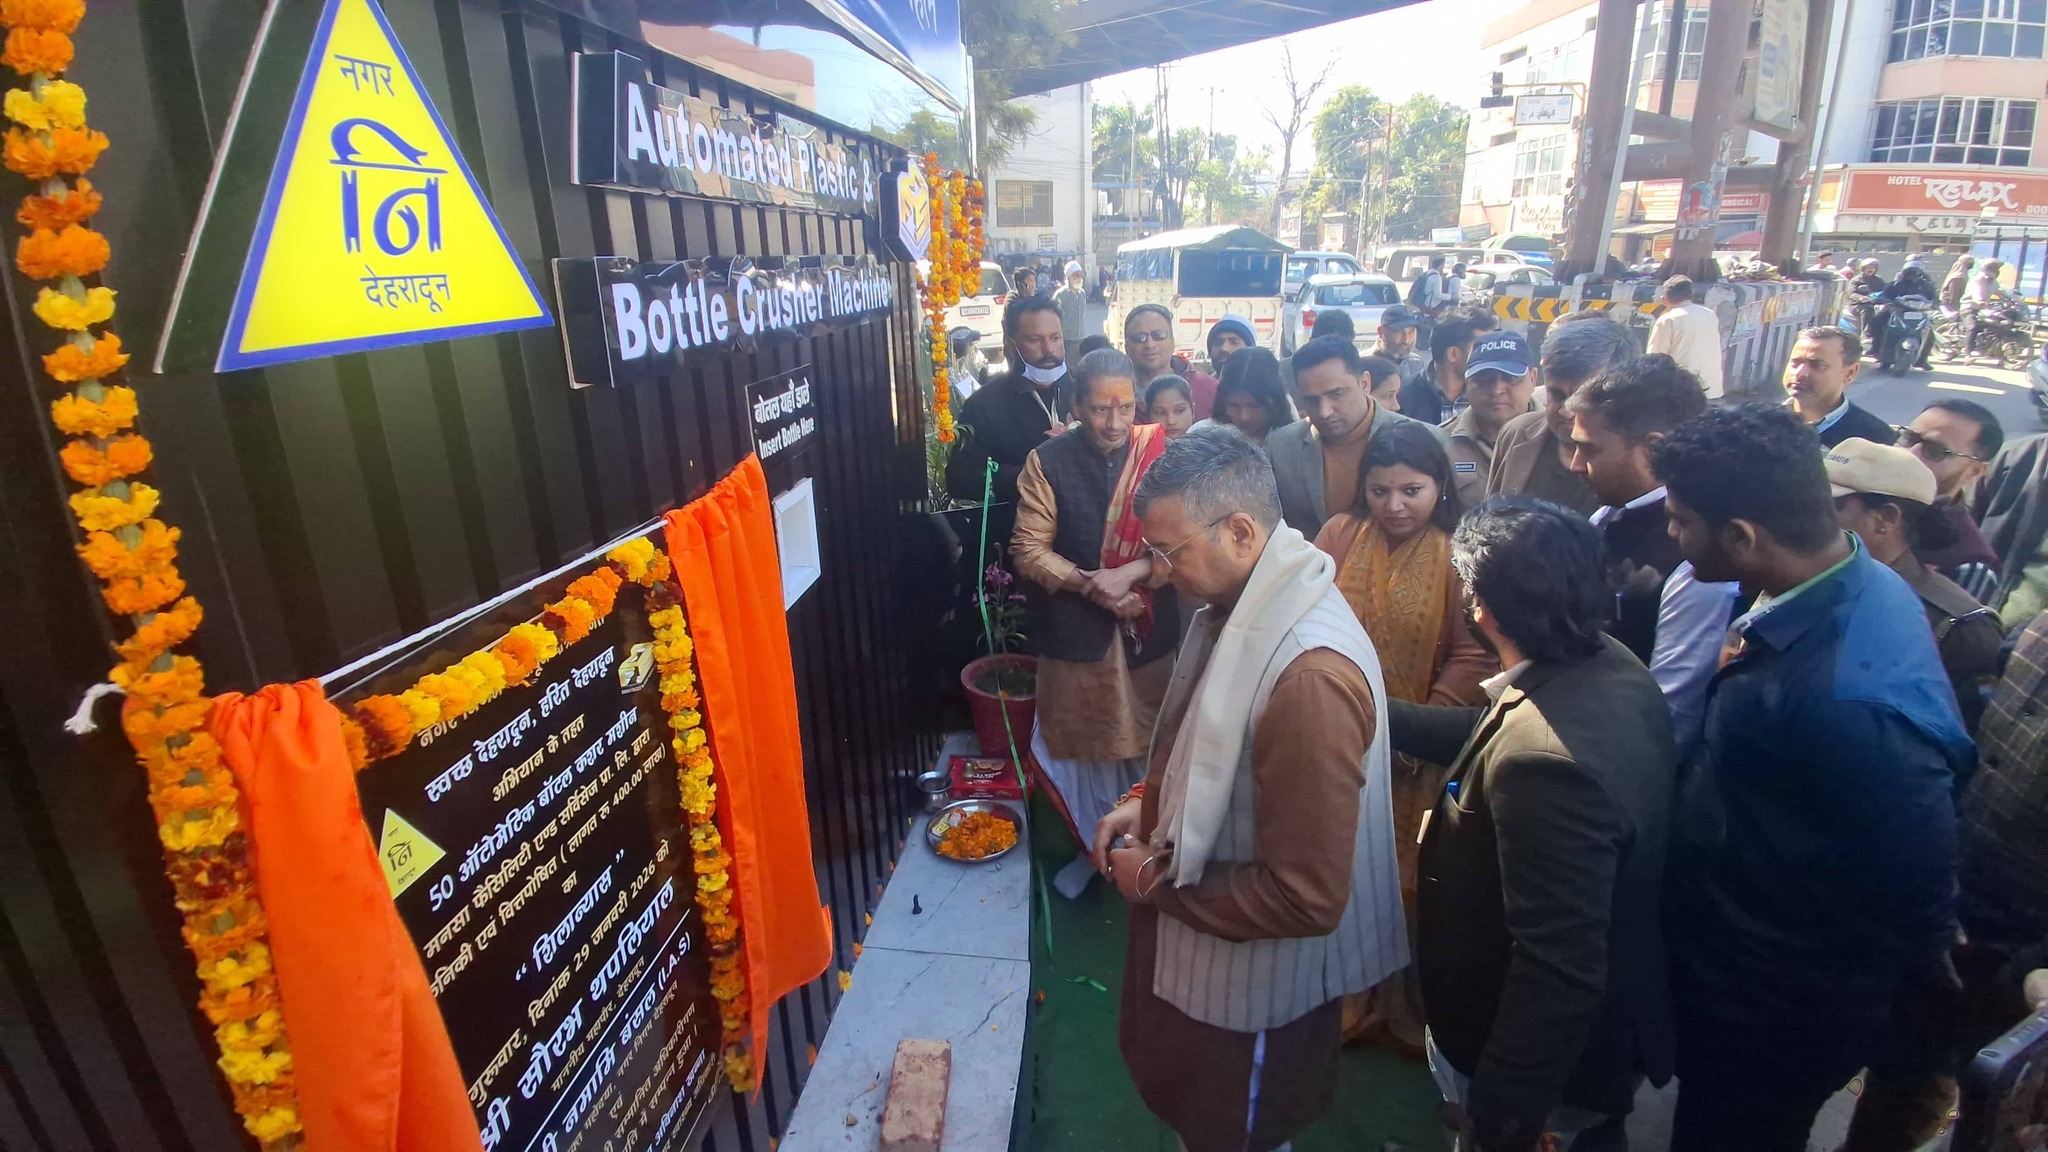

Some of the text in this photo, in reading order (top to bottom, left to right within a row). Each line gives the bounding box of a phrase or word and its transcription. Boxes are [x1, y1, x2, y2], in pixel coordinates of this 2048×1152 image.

[334, 54, 395, 97] नगर
[627, 82, 874, 202] Automated Plastic &
[1887, 176, 2018, 209] HOTEL RELAX
[360, 264, 451, 312] देहरादून
[612, 275, 729, 361] Bottle
[736, 271, 824, 335] Crusher
[1480, 340, 1517, 353] POLICE
[758, 417, 814, 460] Insert Bottle Here
[424, 753, 473, 802] स्वच्छ
[472, 708, 537, 763] देहरादून,
[538, 679, 570, 718] हरित
[571, 646, 614, 689] देहरादून
[492, 714, 585, 802] अभियान के तहत
[429, 874, 454, 912] 50
[459, 799, 535, 882] ऑटोमेटिक
[537, 765, 573, 807] बॉटल
[605, 706, 638, 746] मशीन
[423, 905, 470, 959] मनसा
[472, 841, 532, 909] फैसिलिटी
[533, 818, 557, 851] एण्ड
[475, 915, 497, 951] एवं
[567, 814, 598, 853] लागत
[612, 769, 643, 807] 400.00
[561, 871, 578, 894] का
[528, 965, 571, 1028] दिनांक
[573, 943, 590, 972] 29
[591, 890, 628, 946] जनवरी
[630, 861, 656, 899] 2026
[656, 839, 670, 863] को
[532, 865, 613, 973] शिलान्यास
[517, 998, 584, 1100] सौरभ
[590, 875, 674, 1002] थपलियाल
[562, 1042, 616, 1133] नमामि
[619, 982, 656, 1045] बंसल
[658, 931, 691, 991] (I.A.S)
[551, 1043, 585, 1092] माननीय
